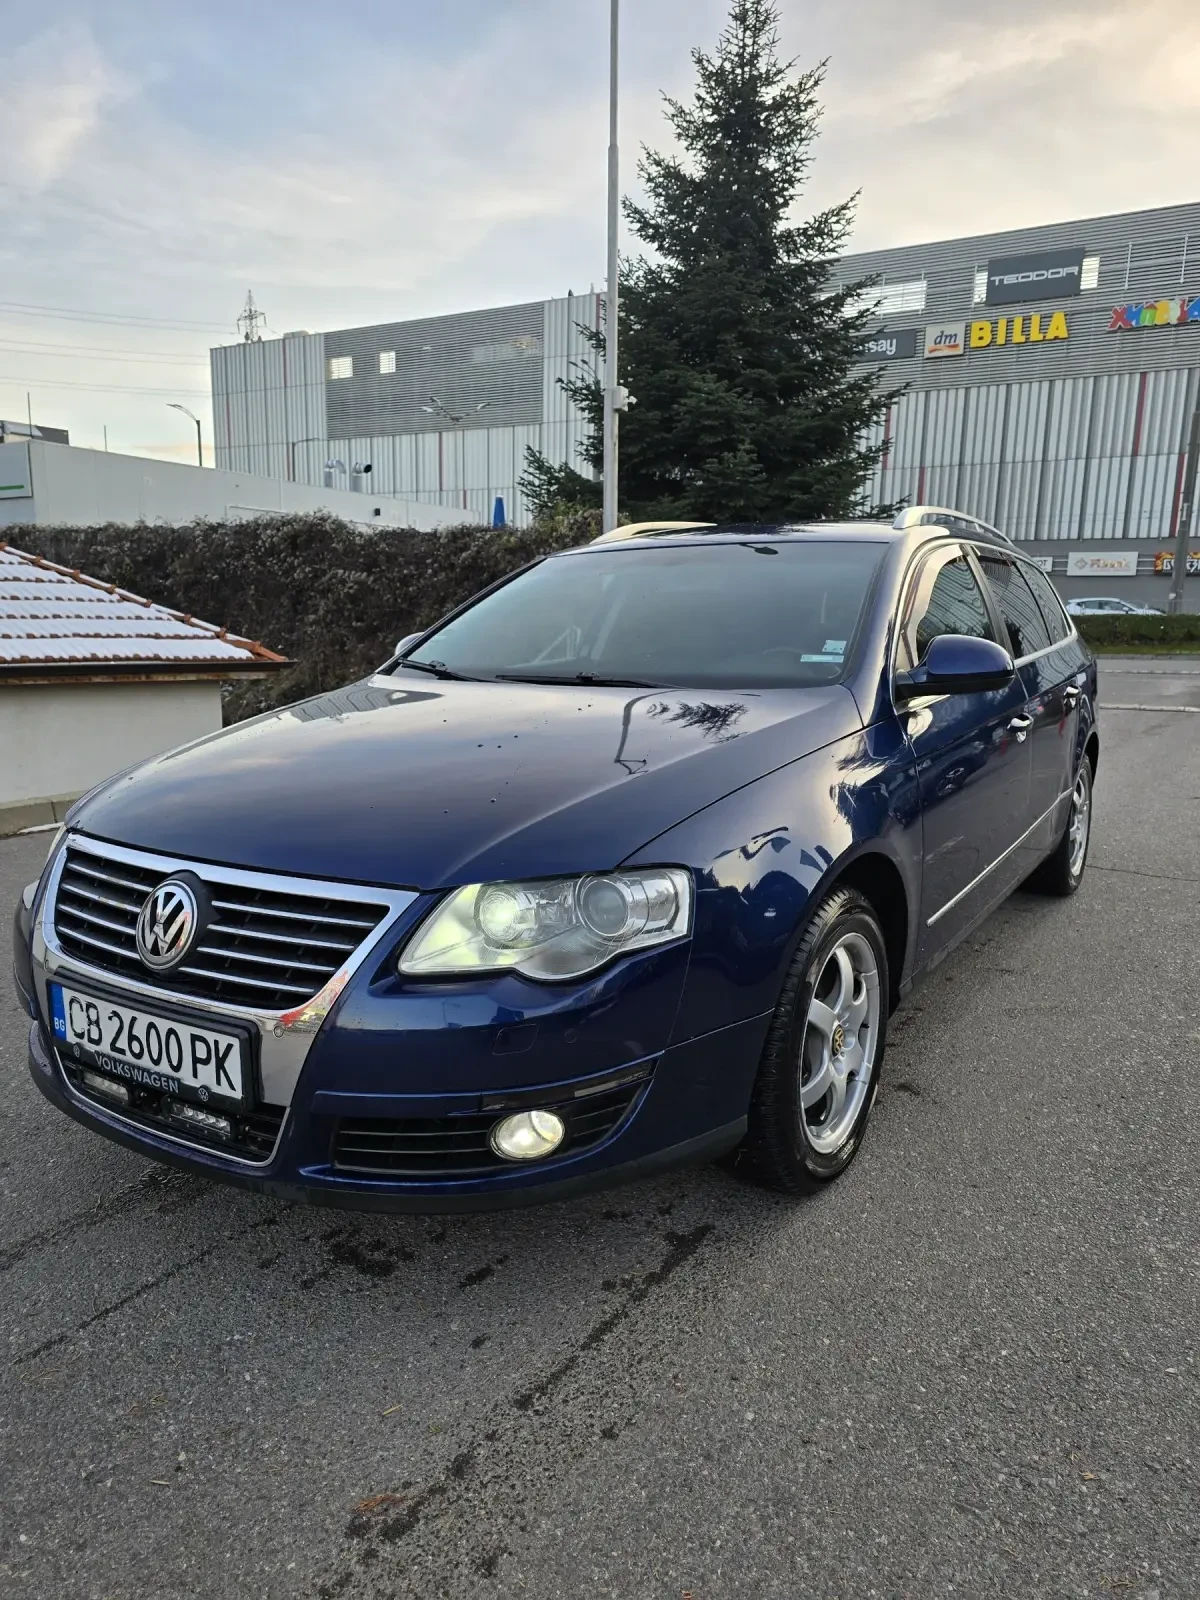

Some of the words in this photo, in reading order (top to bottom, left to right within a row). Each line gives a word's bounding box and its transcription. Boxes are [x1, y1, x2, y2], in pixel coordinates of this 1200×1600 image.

[990, 266, 1079, 286] TEODOR
[933, 330, 958, 347] dm
[969, 312, 1068, 348] BILLA
[54, 1016, 66, 1032] BG
[108, 1009, 184, 1074] 2600
[189, 1032, 237, 1092] PK
[95, 1052, 179, 1094] VOLKSWAGEN
